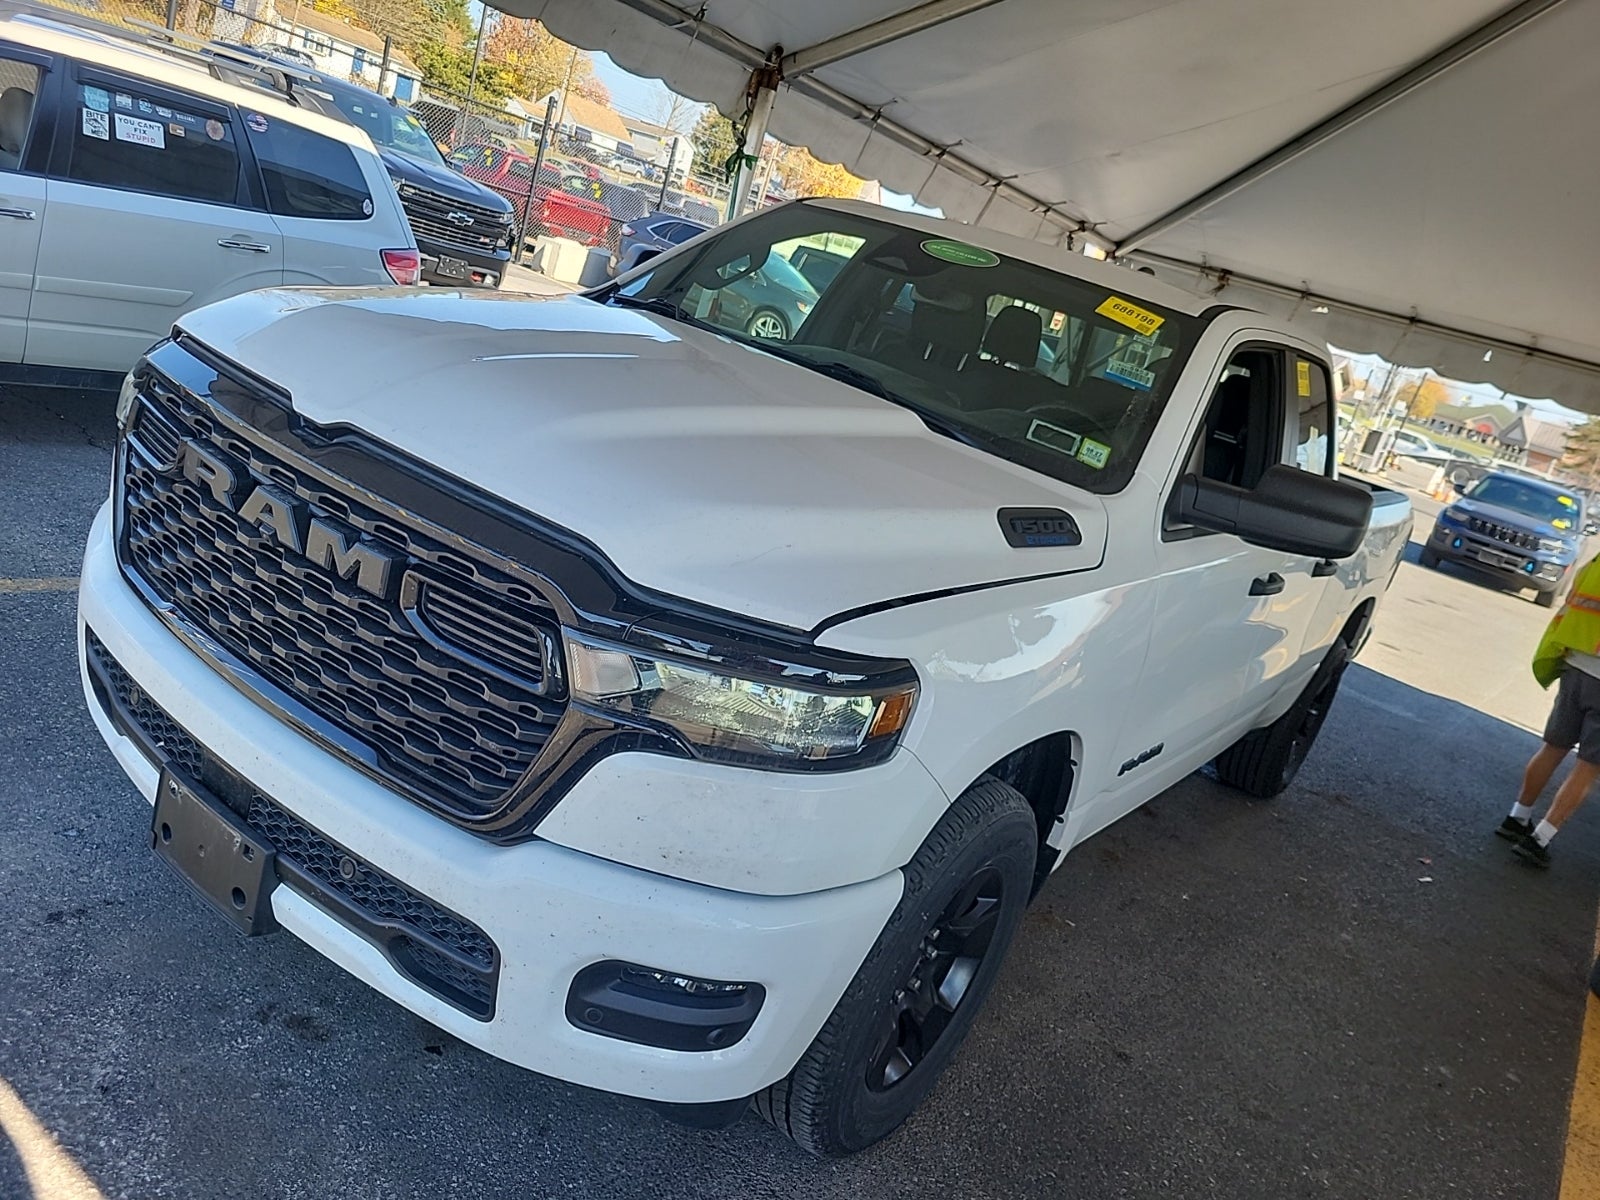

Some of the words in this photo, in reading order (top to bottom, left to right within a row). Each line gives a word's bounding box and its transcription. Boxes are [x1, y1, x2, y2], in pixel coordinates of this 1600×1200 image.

[86, 110, 106, 121] BITE
[118, 116, 135, 126] YOU
[137, 121, 162, 132] CAN'T
[133, 127, 147, 135] FIX
[125, 132, 156, 144] STUPID
[1112, 303, 1156, 326] 688198
[183, 440, 392, 600] RAM
[1009, 518, 1070, 534] 1500
